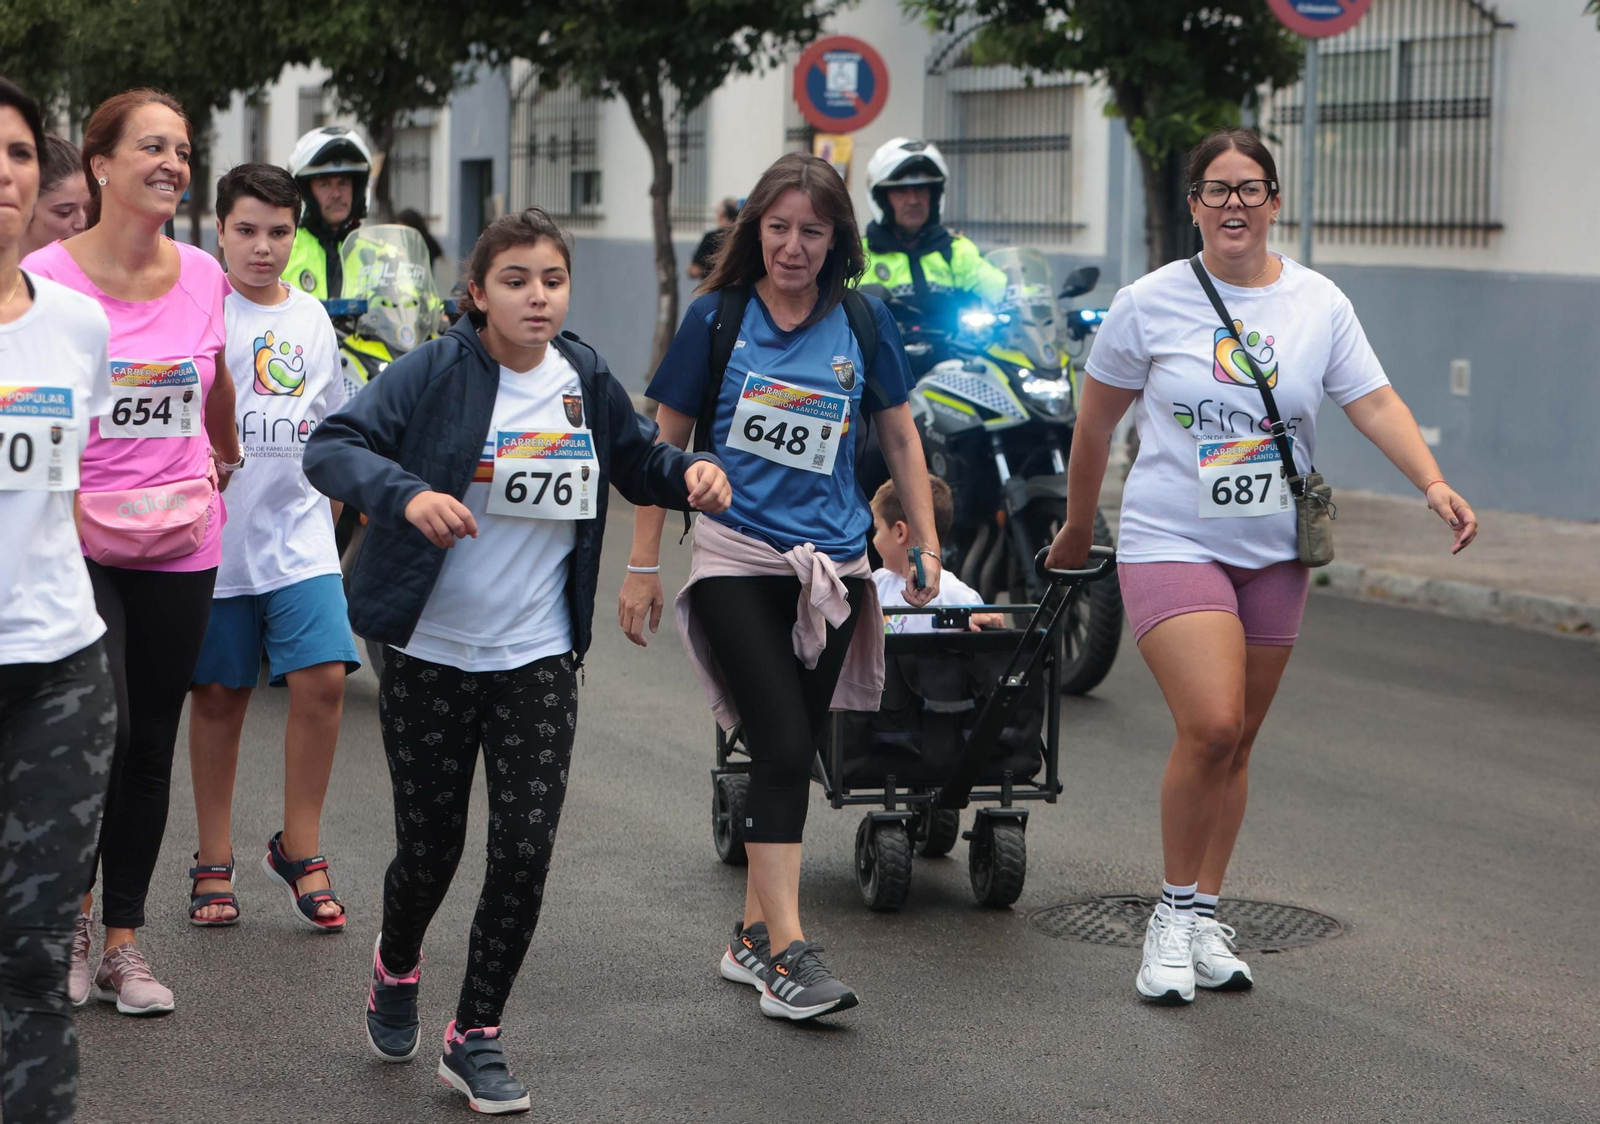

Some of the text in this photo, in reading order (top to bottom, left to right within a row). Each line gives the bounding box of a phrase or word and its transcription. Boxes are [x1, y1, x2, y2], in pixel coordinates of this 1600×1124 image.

[112, 366, 193, 378] CARRERA POPULAR
[181, 376, 197, 384] ANGEL
[8, 392, 65, 404] POPULAR
[753, 383, 838, 411] CARRERA POPULAR
[6, 405, 72, 416] SANTO ANGEL
[111, 396, 172, 426] 654
[795, 405, 819, 416] SANTO
[819, 409, 840, 420] ANGEL
[743, 414, 810, 456] 648
[502, 437, 587, 448] CARRERA POPULAR
[553, 449, 573, 457] SANTO
[1206, 443, 1280, 457] CARRERA POPUL
[1252, 452, 1274, 461] SANTO
[504, 471, 573, 506] 676
[1211, 473, 1272, 505] 687
[118, 492, 188, 517] adidas
